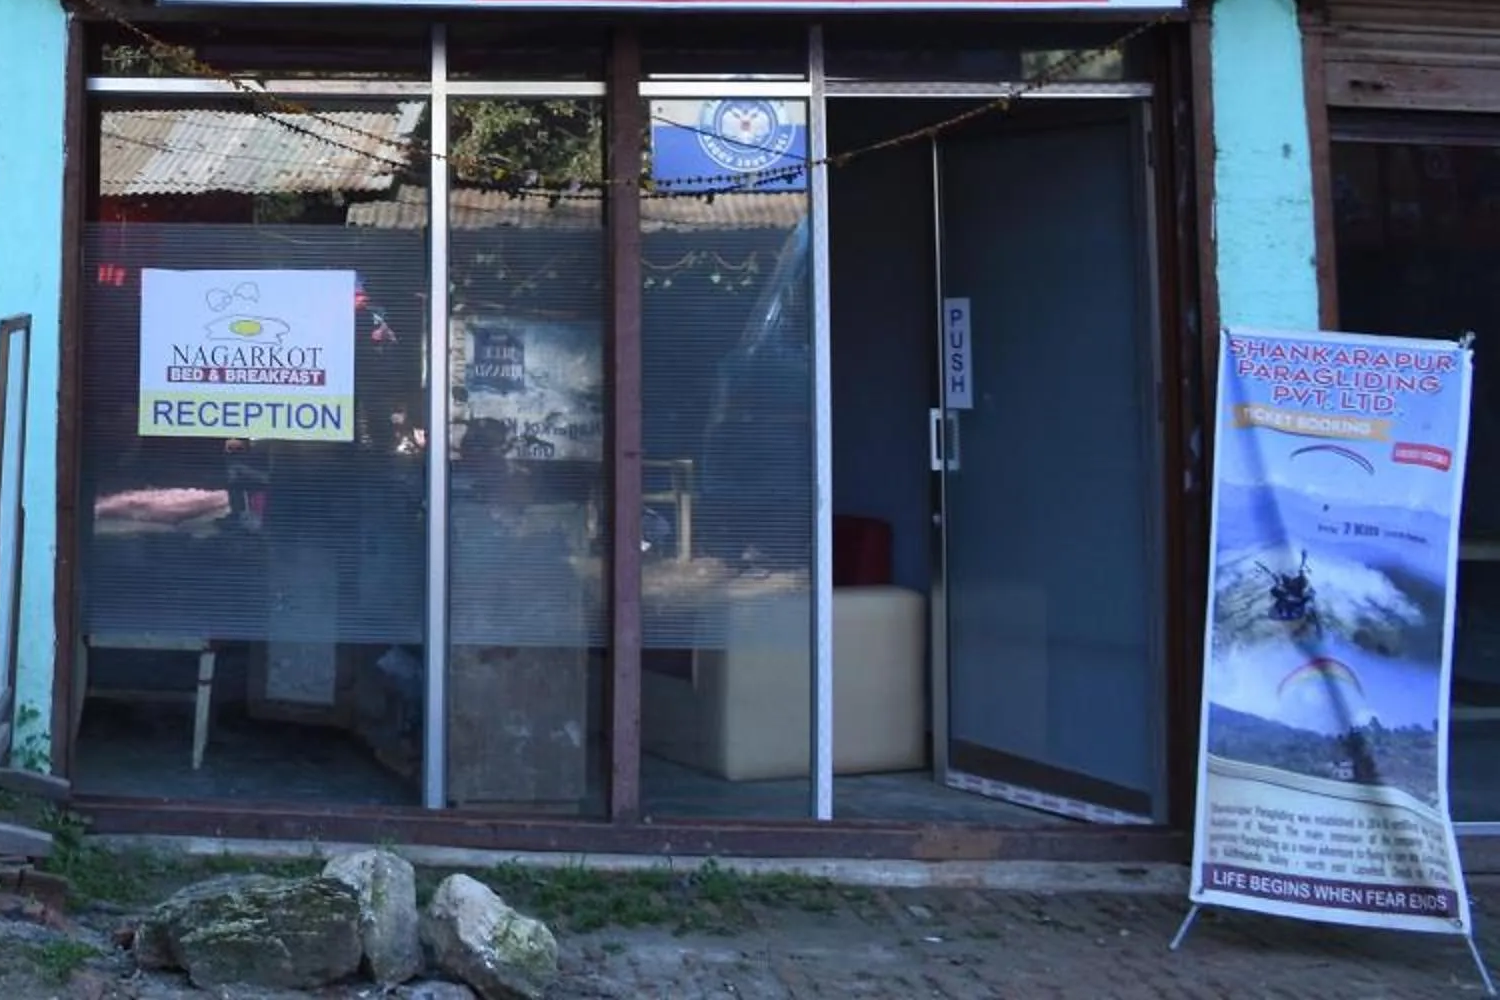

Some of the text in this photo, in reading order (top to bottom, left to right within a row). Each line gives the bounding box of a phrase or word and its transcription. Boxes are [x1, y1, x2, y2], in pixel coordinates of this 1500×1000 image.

[171, 343, 323, 369] NAGARKOT
[950, 308, 965, 393] PUSH
[1230, 337, 1455, 373] SHANKARAPUR
[170, 368, 323, 384] BED & BREAKFAST
[1237, 359, 1442, 393] PARAGLIDING
[152, 399, 342, 430] RECEPTION
[1212, 870, 1448, 911] LIFE BEGINS WHEN FEAR ENDS
